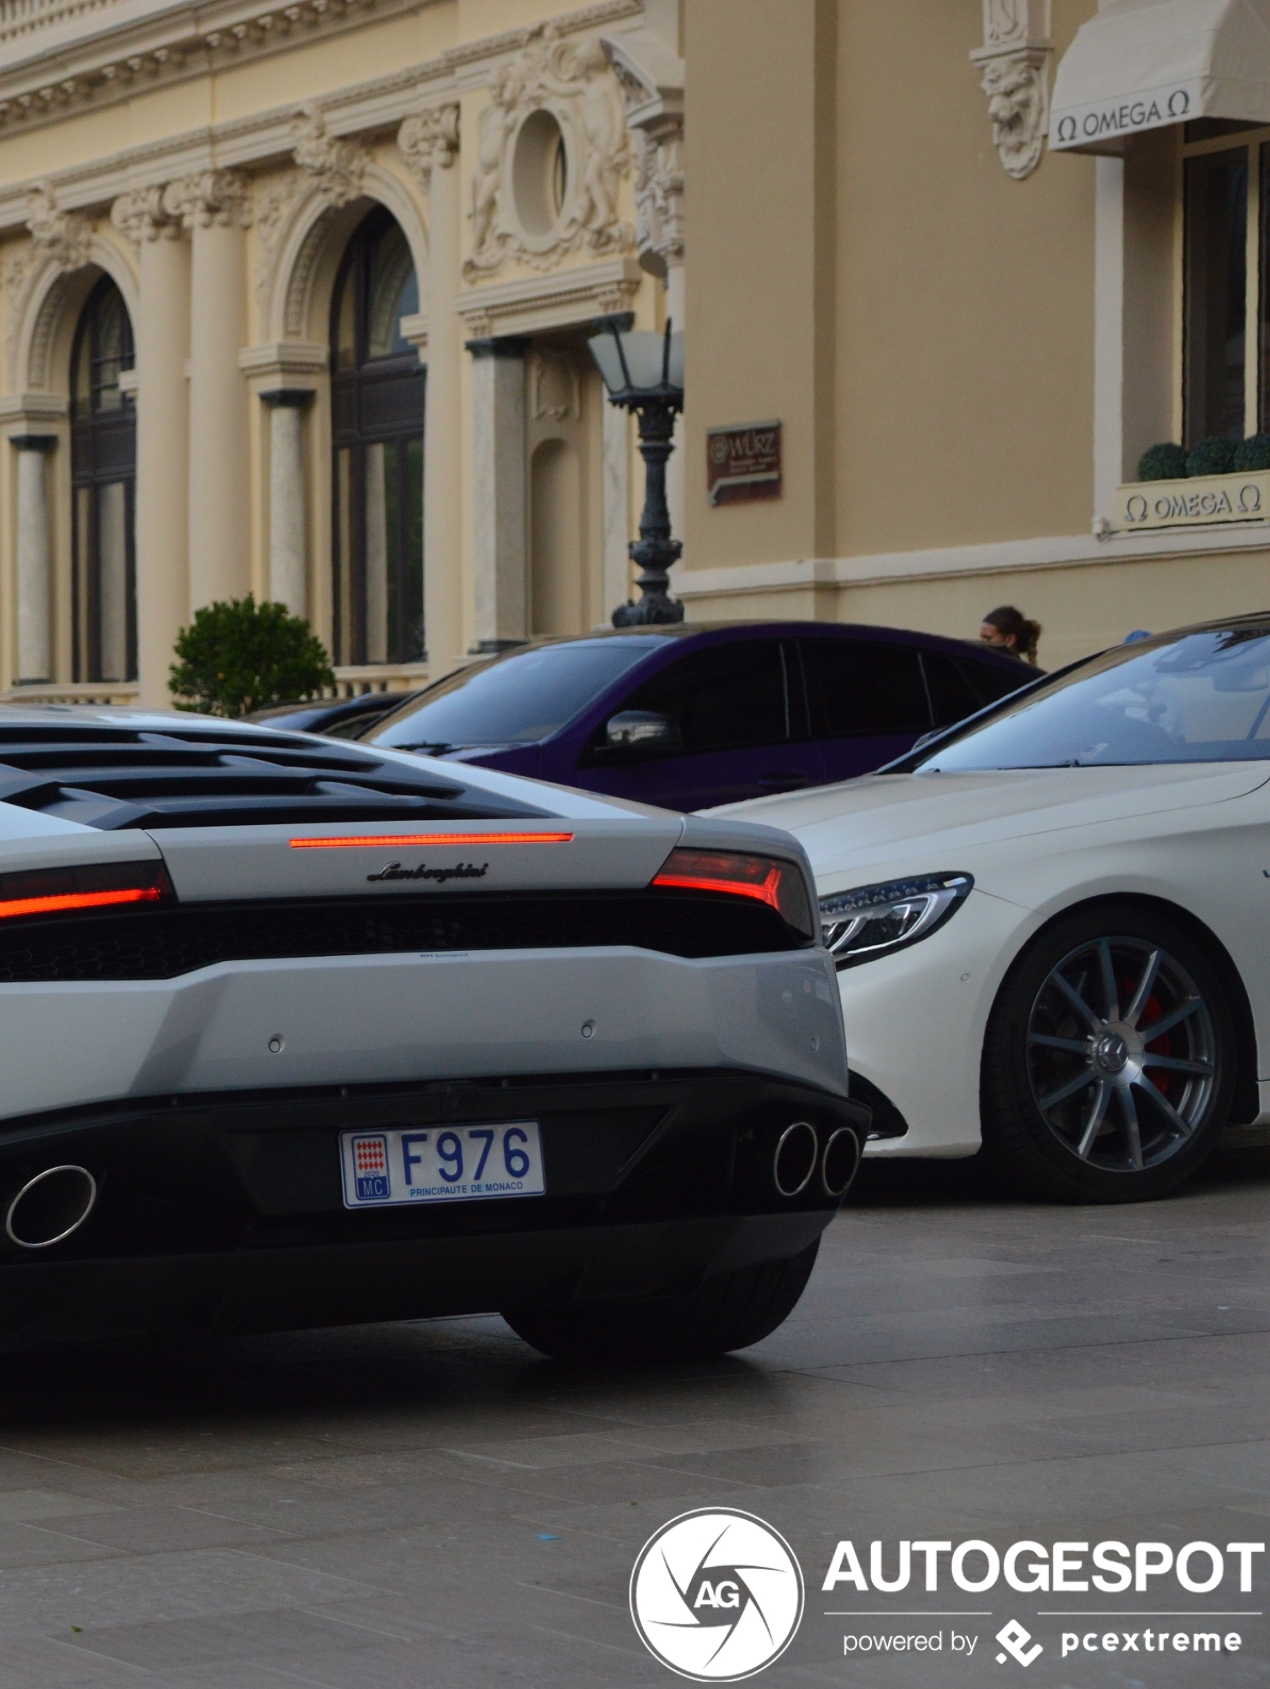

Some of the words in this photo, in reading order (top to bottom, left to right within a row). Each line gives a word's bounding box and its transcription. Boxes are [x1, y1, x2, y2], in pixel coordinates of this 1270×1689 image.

[1083, 101, 1162, 136] OMEGA
[1155, 490, 1233, 519] OMEGA
[366, 861, 489, 883] Lamborghini
[401, 1127, 530, 1186] F976
[363, 1179, 383, 1196] MC
[410, 1185, 468, 1197] PRINCIPAUTE
[471, 1184, 483, 1193] DE
[485, 1181, 524, 1192] MONACO
